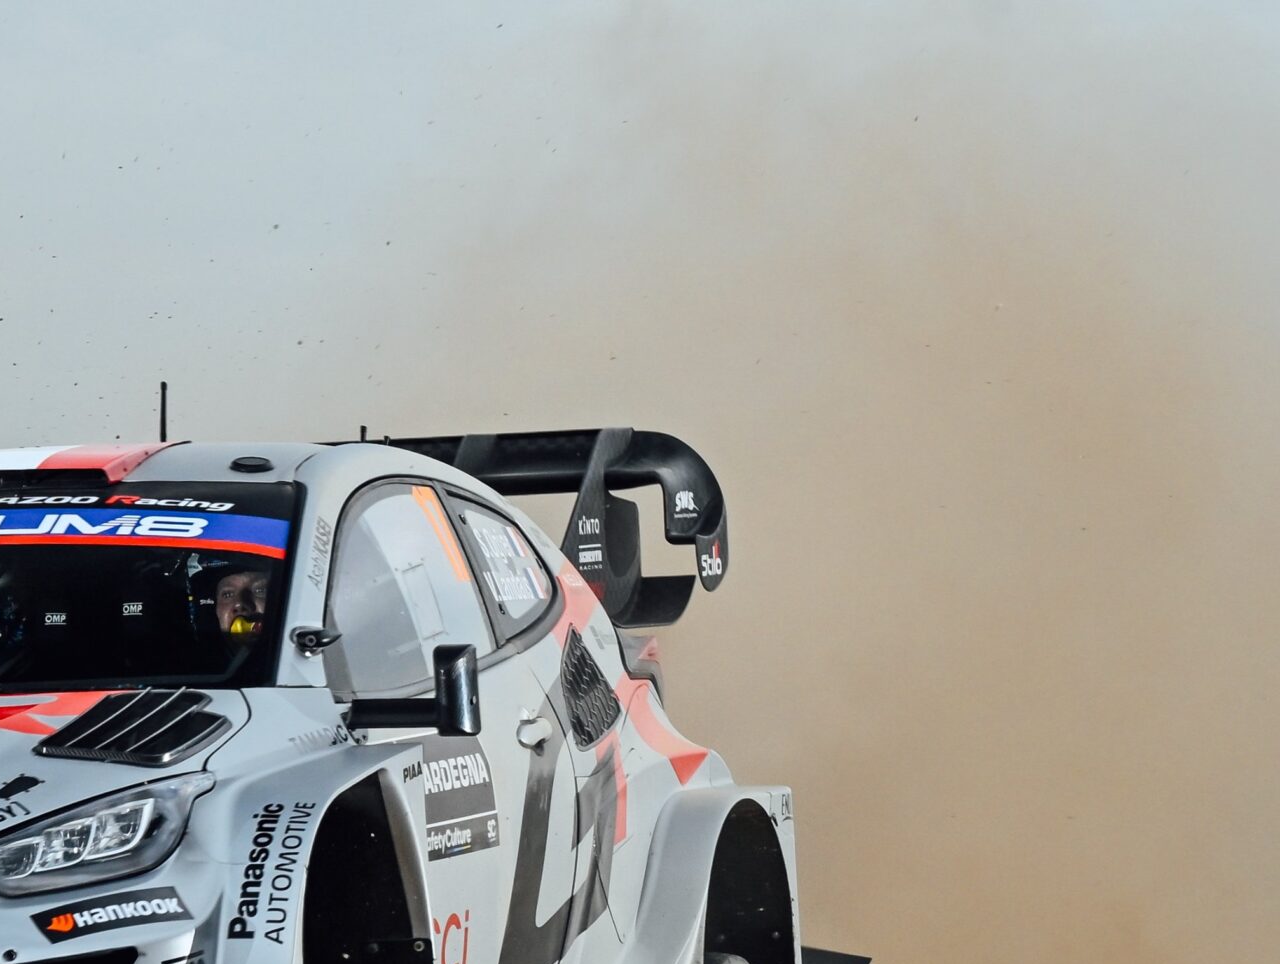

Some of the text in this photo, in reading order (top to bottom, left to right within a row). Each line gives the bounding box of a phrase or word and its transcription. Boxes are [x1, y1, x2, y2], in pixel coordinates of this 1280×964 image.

[105, 495, 235, 511] Racing
[675, 490, 697, 511] SWS
[45, 614, 66, 623] OMP
[123, 604, 142, 613] OMP
[403, 761, 423, 783] PIAA
[423, 753, 490, 795] ARDEGNA
[427, 827, 472, 855] afetyCulture
[227, 803, 284, 939] Panasonic
[264, 802, 316, 945] AUTOMOTIVE
